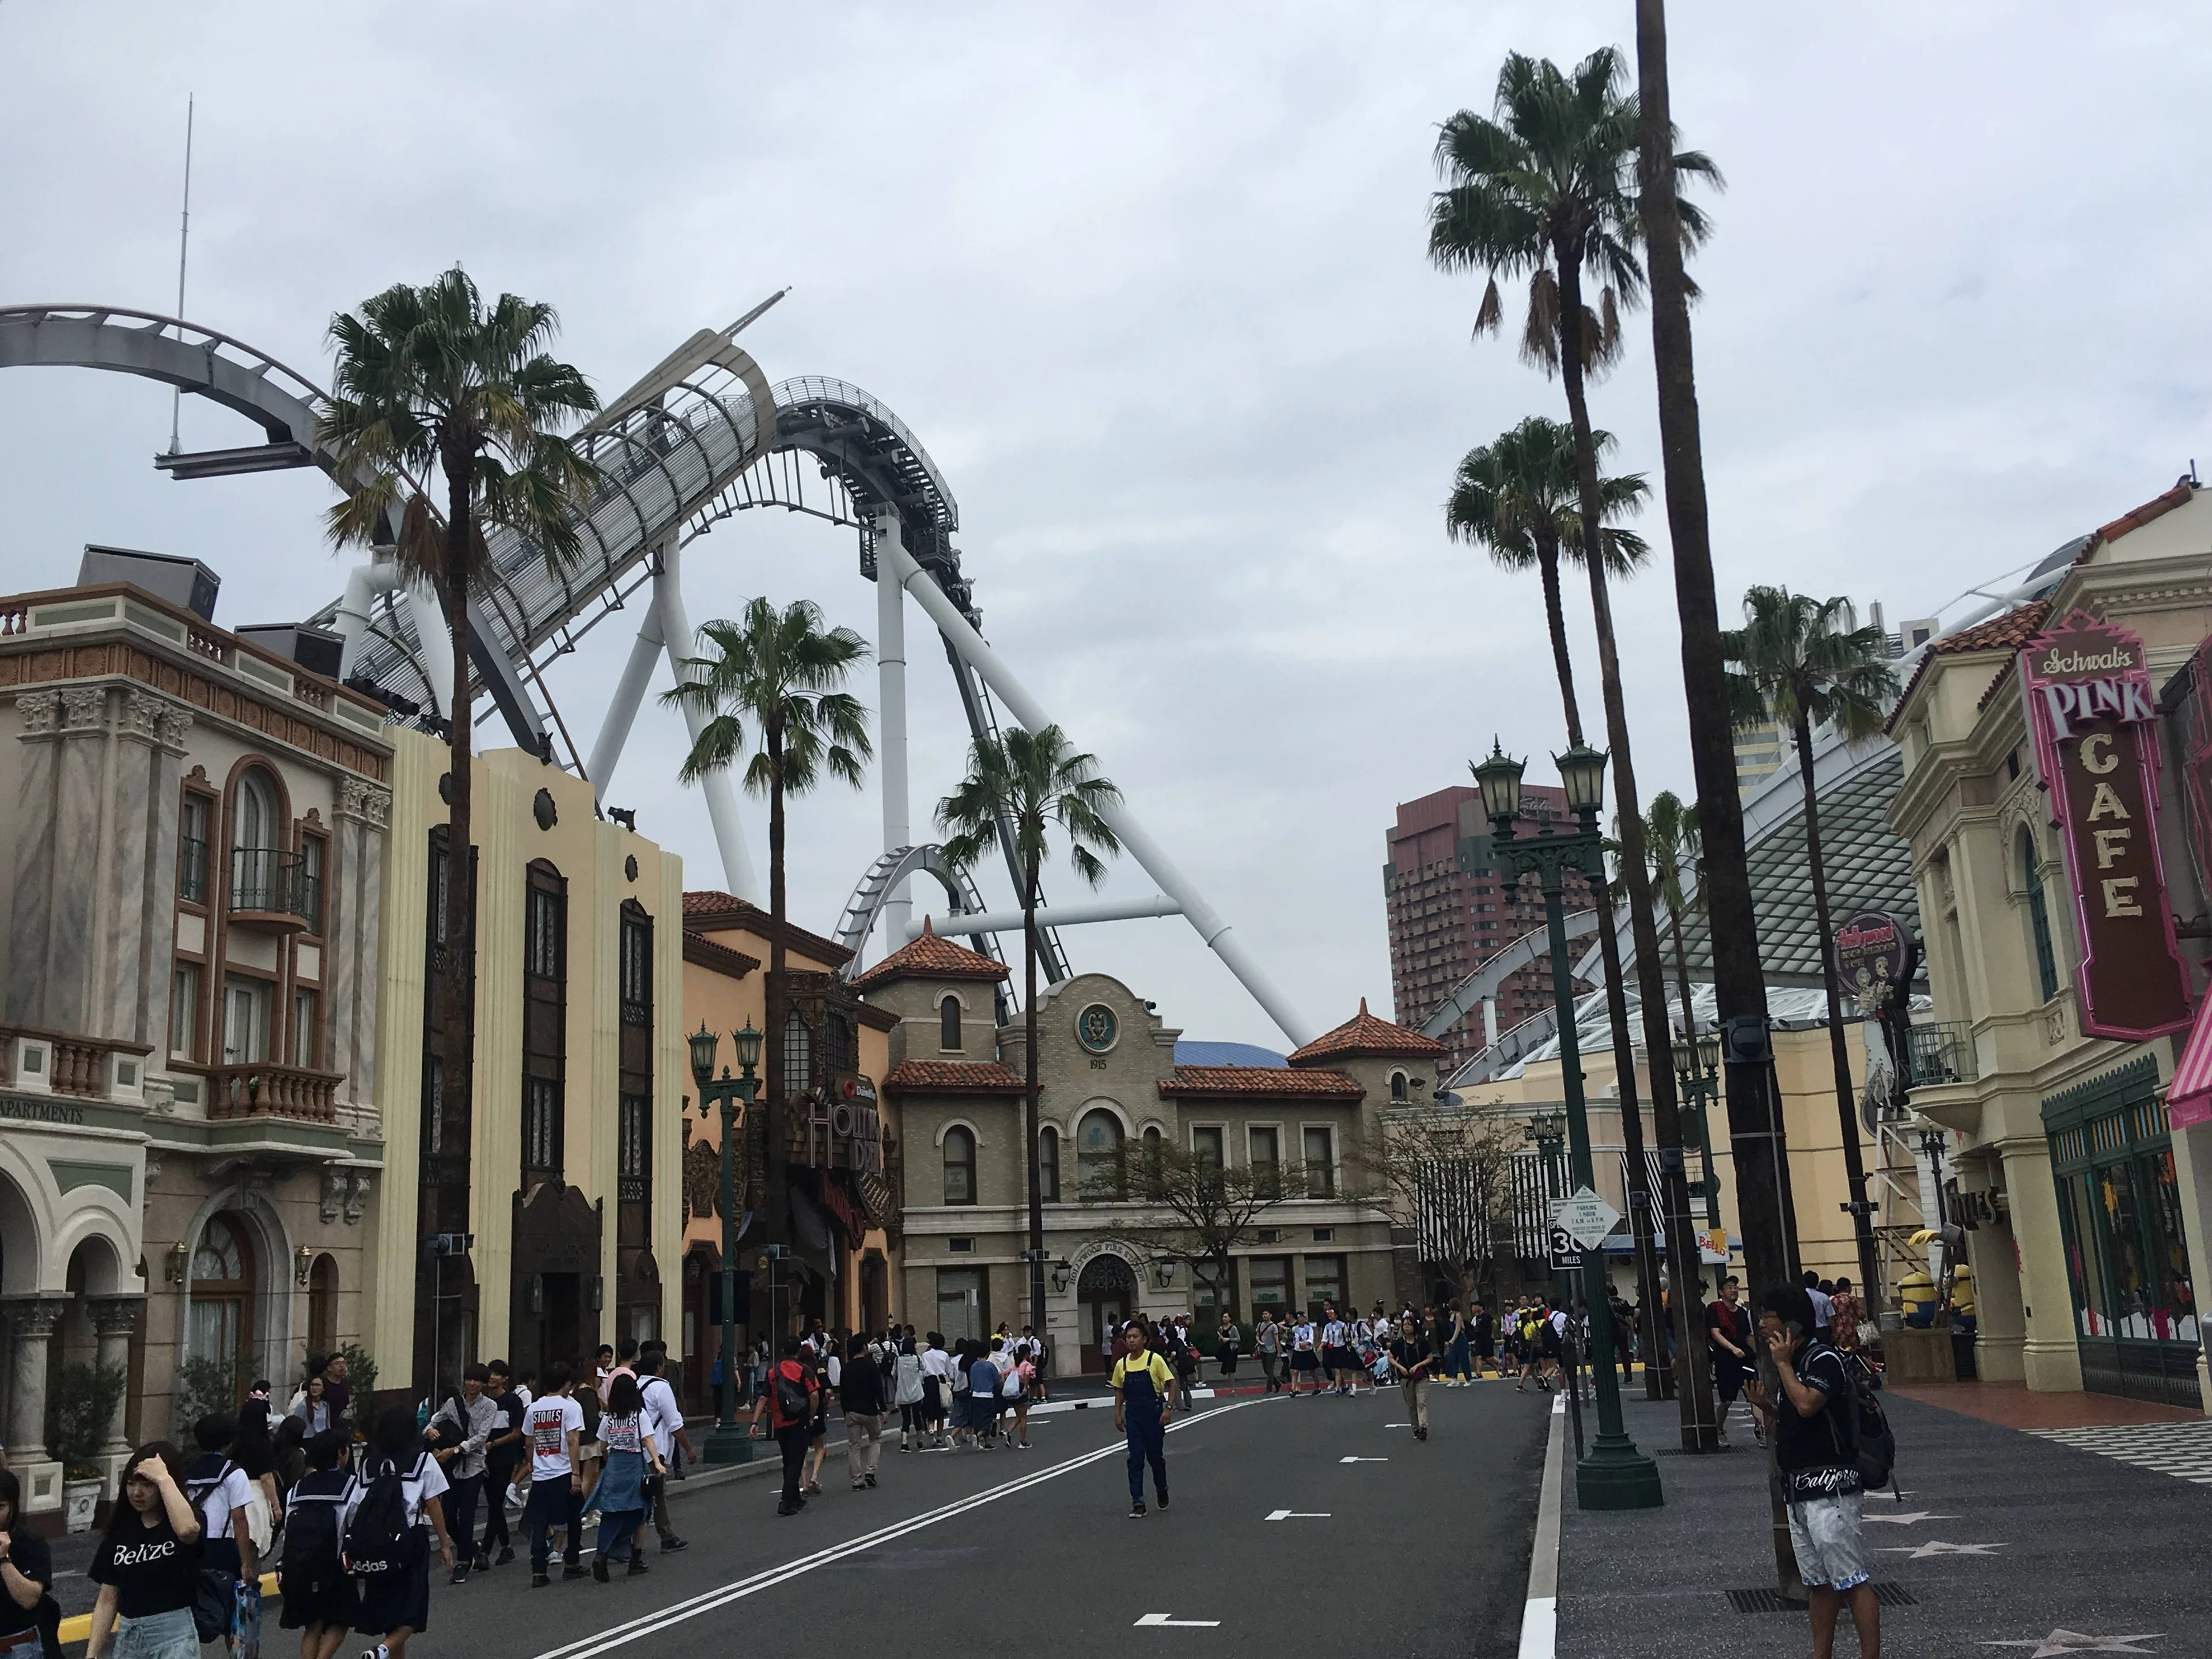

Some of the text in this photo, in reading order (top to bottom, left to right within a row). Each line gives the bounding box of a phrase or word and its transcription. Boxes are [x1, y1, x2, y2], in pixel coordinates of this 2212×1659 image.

[2042, 646, 2133, 674] Schwab's
[2035, 676, 2160, 743] PINK
[2080, 733, 2142, 918] CAFE
[1090, 1059, 1107, 1070] 1915
[0, 1099, 83, 1123] APARTMENTS
[1699, 1236, 1726, 1256] BELLO
[1070, 1244, 1102, 1285] HOLLYWOOD
[1562, 1256, 1581, 1264] MILES
[113, 1540, 175, 1566] Belize
